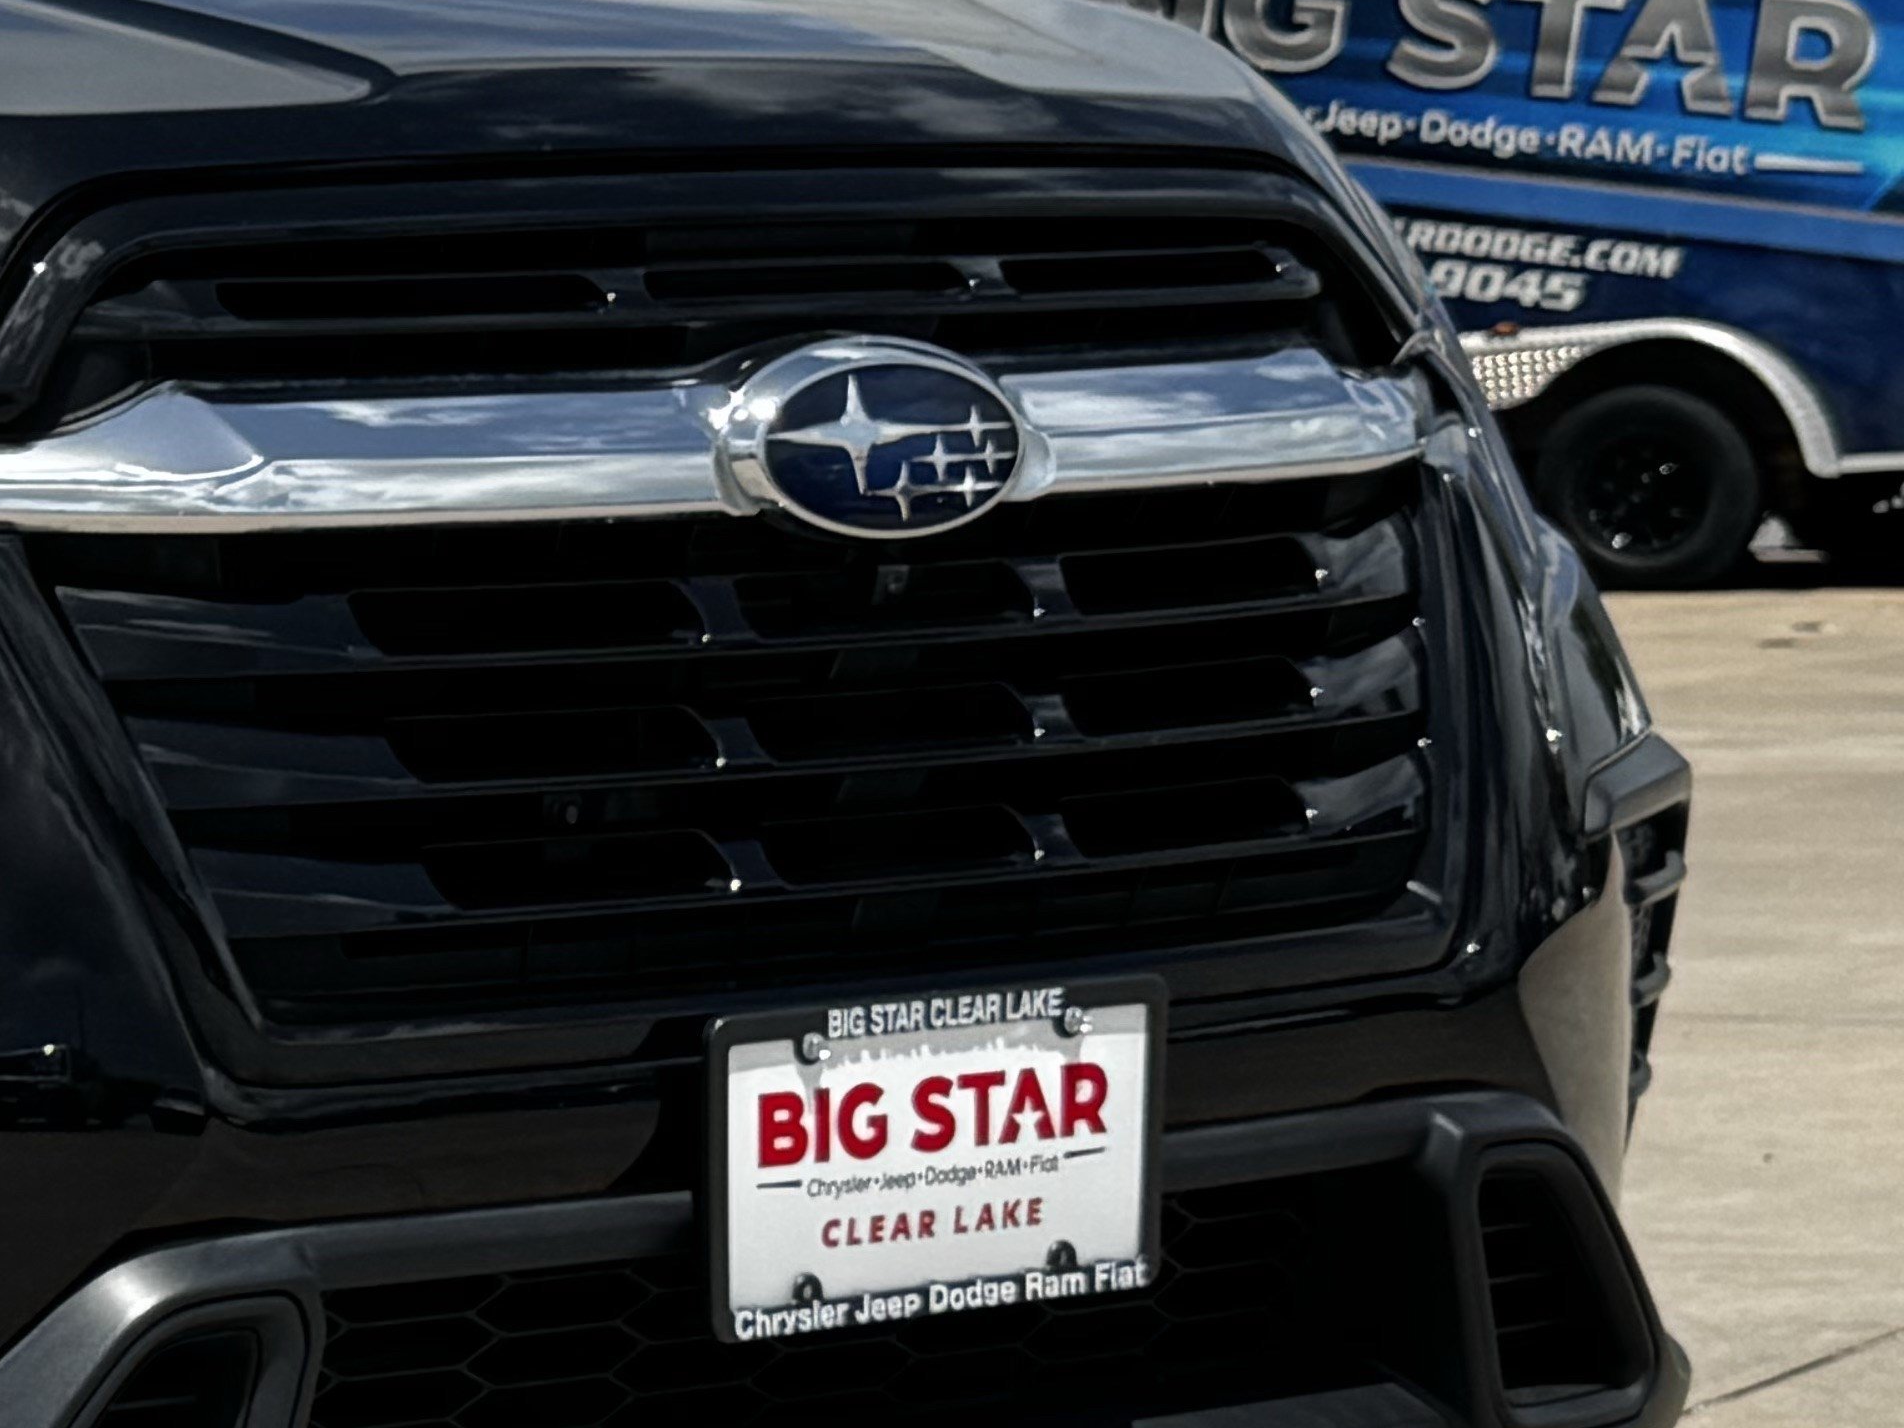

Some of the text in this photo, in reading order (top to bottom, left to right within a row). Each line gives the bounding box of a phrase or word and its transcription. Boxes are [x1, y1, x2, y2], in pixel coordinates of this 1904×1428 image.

[1419, 107, 1542, 160] Dodge
[1558, 123, 1654, 167] RAM
[1671, 135, 1751, 175] Fiat
[1390, 215, 1686, 279] RDODGE.COM
[828, 987, 1064, 1039] BIG STAR CLEAR LAKE
[757, 1062, 1108, 1169] BIG STAR
[806, 1154, 1059, 1201] Chrysler Jeep Dodge RAM Fiat
[821, 1197, 1044, 1249] CLEAR LAKE
[734, 1256, 1149, 1342] Chrysler Jeep Dodge Ram Fiat
